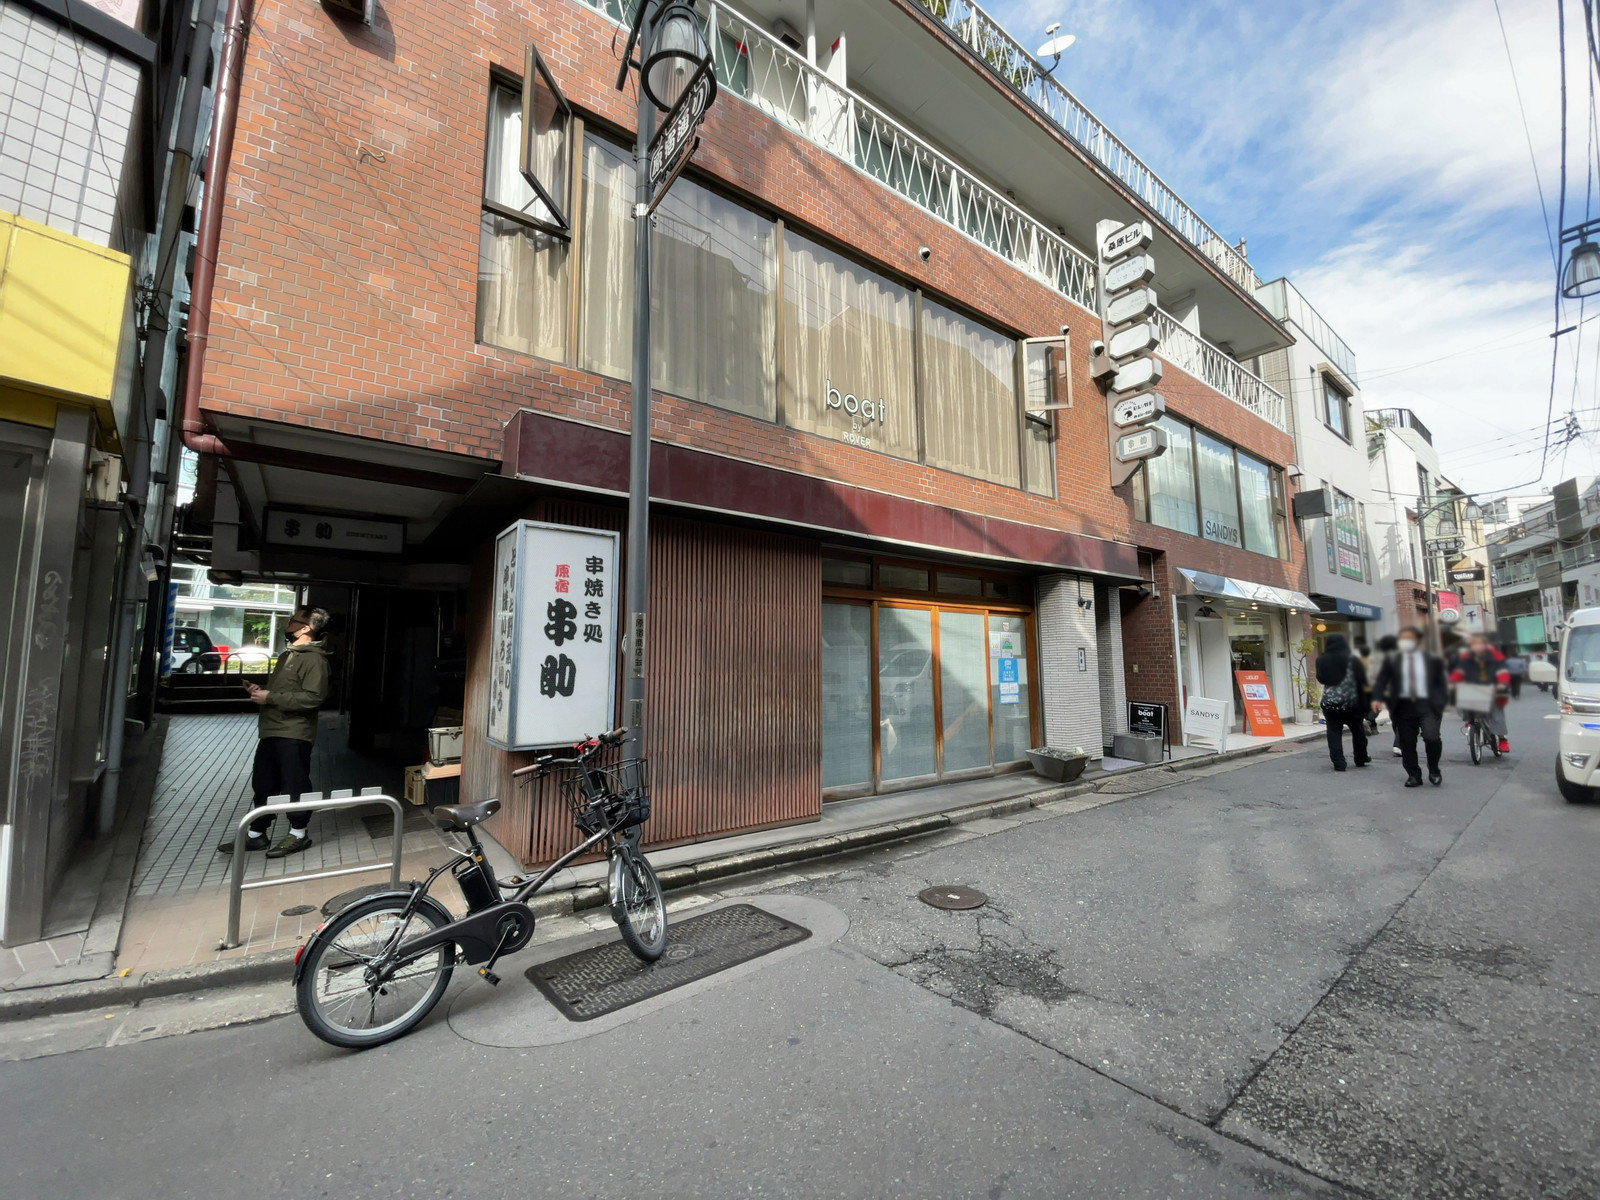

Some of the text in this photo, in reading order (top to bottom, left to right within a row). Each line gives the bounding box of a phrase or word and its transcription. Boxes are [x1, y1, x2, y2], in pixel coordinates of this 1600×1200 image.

[652, 87, 704, 176] 原宿通り
[1108, 229, 1141, 252] 桑原ビル
[825, 379, 885, 424] boat
[842, 431, 871, 448] ROVER
[1205, 520, 1238, 543] SANDYS
[555, 564, 570, 593] 原宿
[583, 555, 604, 643] 串焼き処
[540, 598, 577, 699] 串助
[1138, 709, 1154, 717] boat
[1190, 709, 1220, 720] SANDYS
